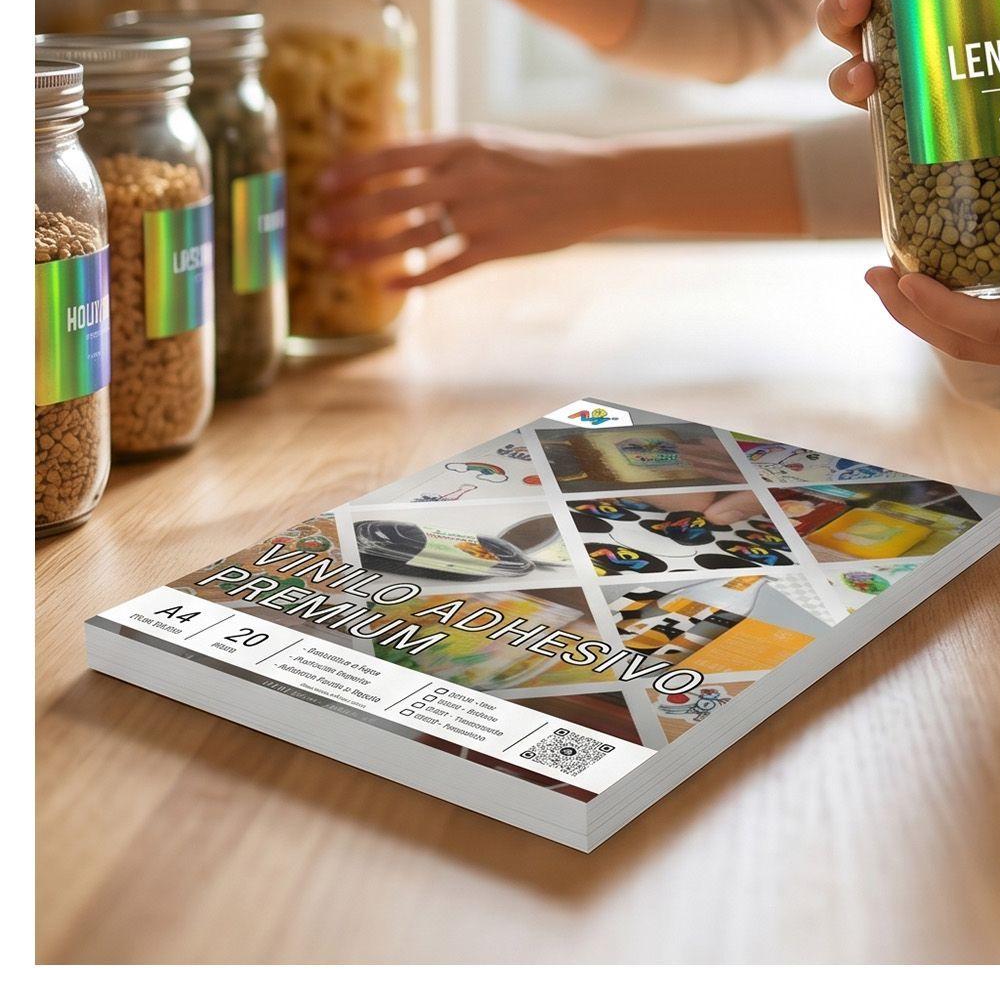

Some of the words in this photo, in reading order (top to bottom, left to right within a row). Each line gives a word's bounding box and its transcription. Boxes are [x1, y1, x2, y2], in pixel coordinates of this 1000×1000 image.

[153, 605, 202, 624] A4
[195, 566, 450, 656] PREMIUM
[224, 627, 270, 647] 20
[253, 543, 422, 606] VINILO
[412, 599, 704, 695] ADHESIVO
